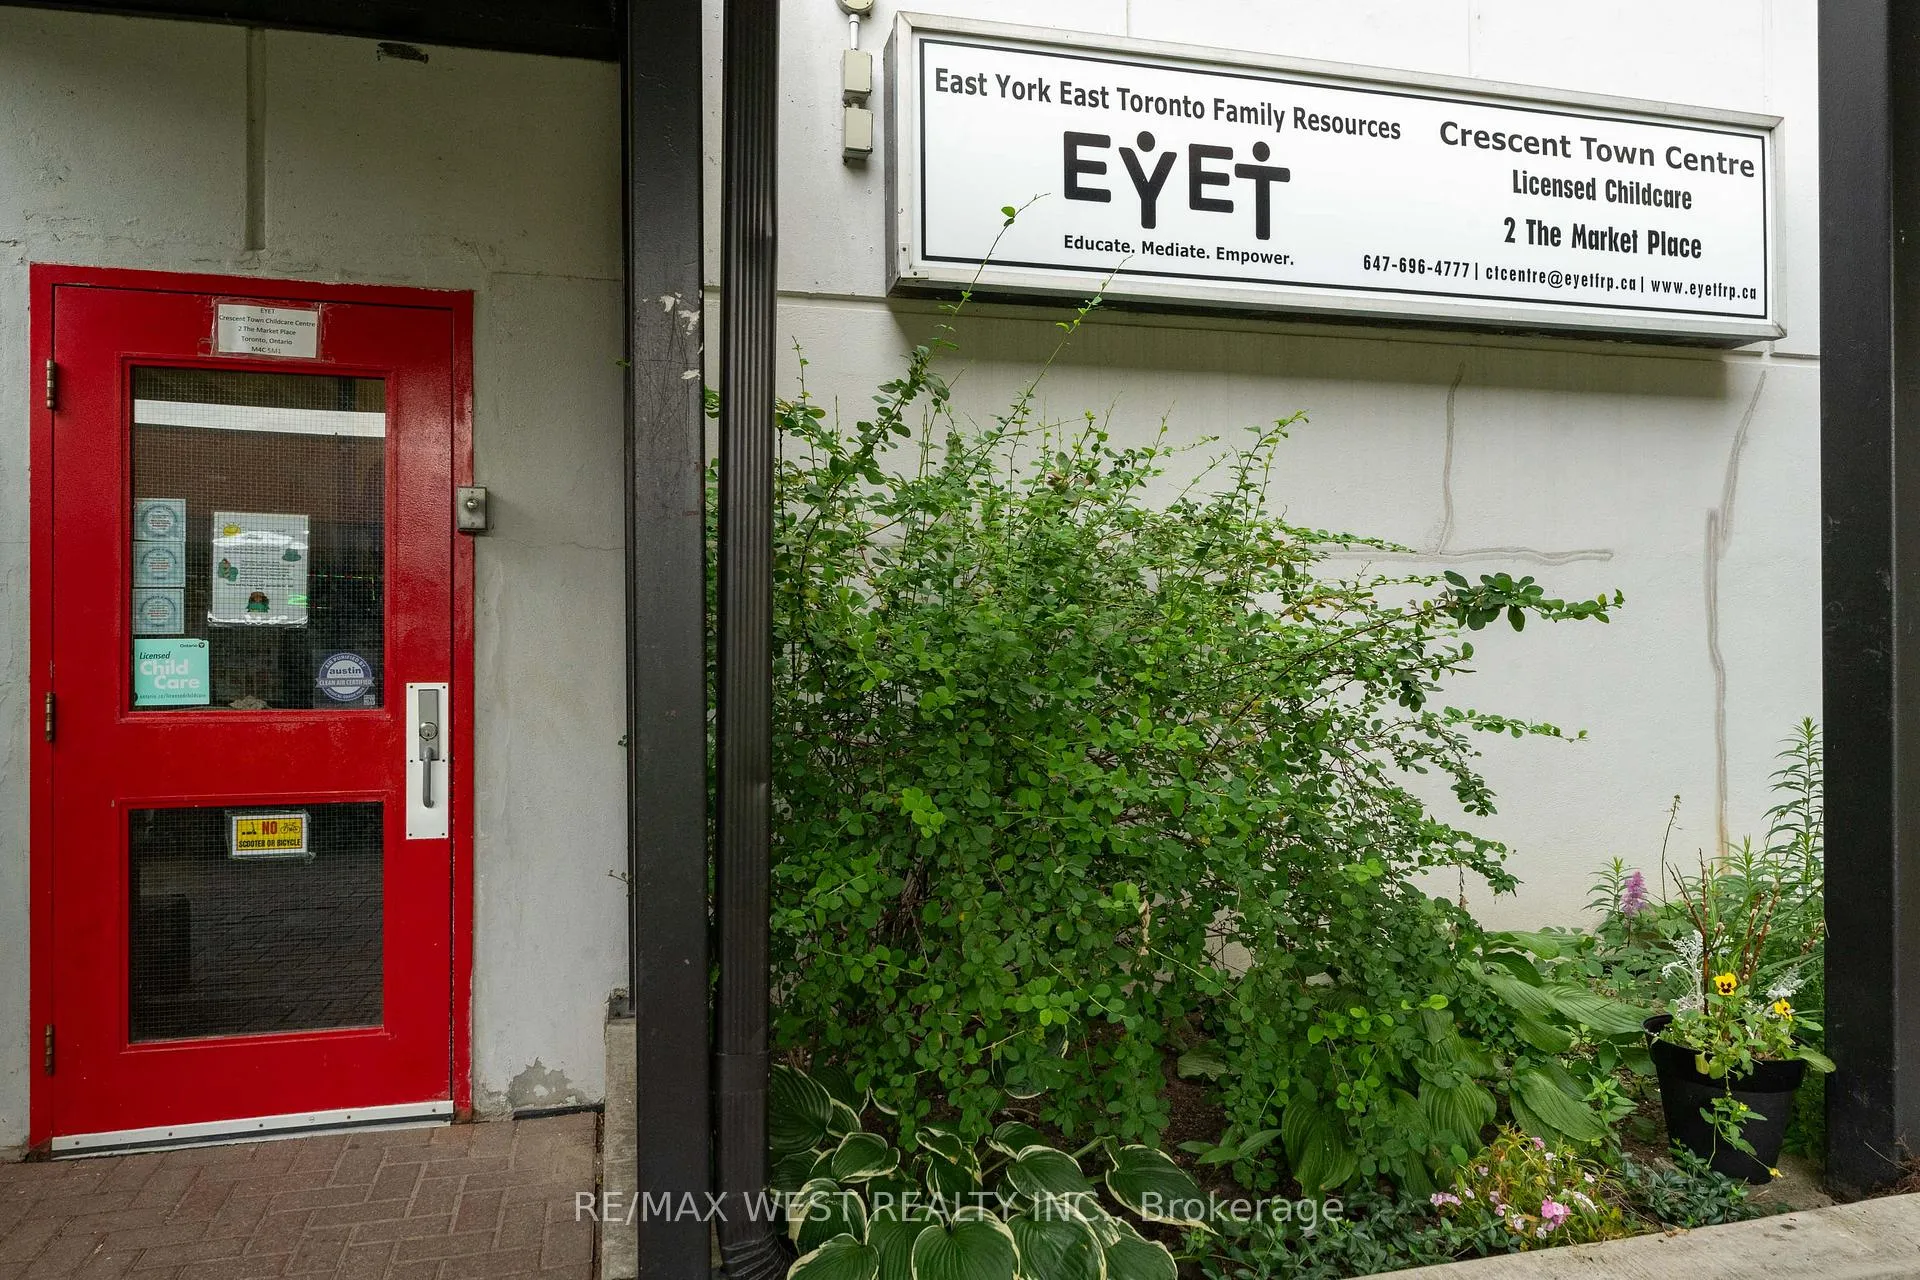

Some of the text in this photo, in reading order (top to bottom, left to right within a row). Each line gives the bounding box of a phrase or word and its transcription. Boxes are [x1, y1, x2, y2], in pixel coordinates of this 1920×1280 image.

[935, 67, 1401, 140] East York East Toronto Family Resources
[1439, 121, 1755, 178] Crescent Town Centre
[1063, 130, 1291, 241] EYET
[1512, 169, 1692, 210] Licensed Childcare
[1503, 216, 1702, 259] 2 The Market Place
[1064, 234, 1294, 266] Educate. Mediate. Empower.
[1363, 254, 1470, 278] 647-696-4777
[1485, 265, 1636, 292] ctcentre@eyetfrp.ca
[1650, 279, 1757, 301] www.eyetfrp.ca
[218, 314, 246, 322] Crescent
[265, 318, 294, 326] Childcare
[241, 335, 268, 344] Toronto,
[256, 327, 279, 335] Market
[280, 328, 297, 336] Place
[139, 651, 171, 660] Licensed
[139, 658, 189, 676] Child
[154, 675, 201, 690] Care
[261, 821, 278, 835] NO
[239, 840, 266, 848] SCOOTER
[266, 839, 276, 847] OR
